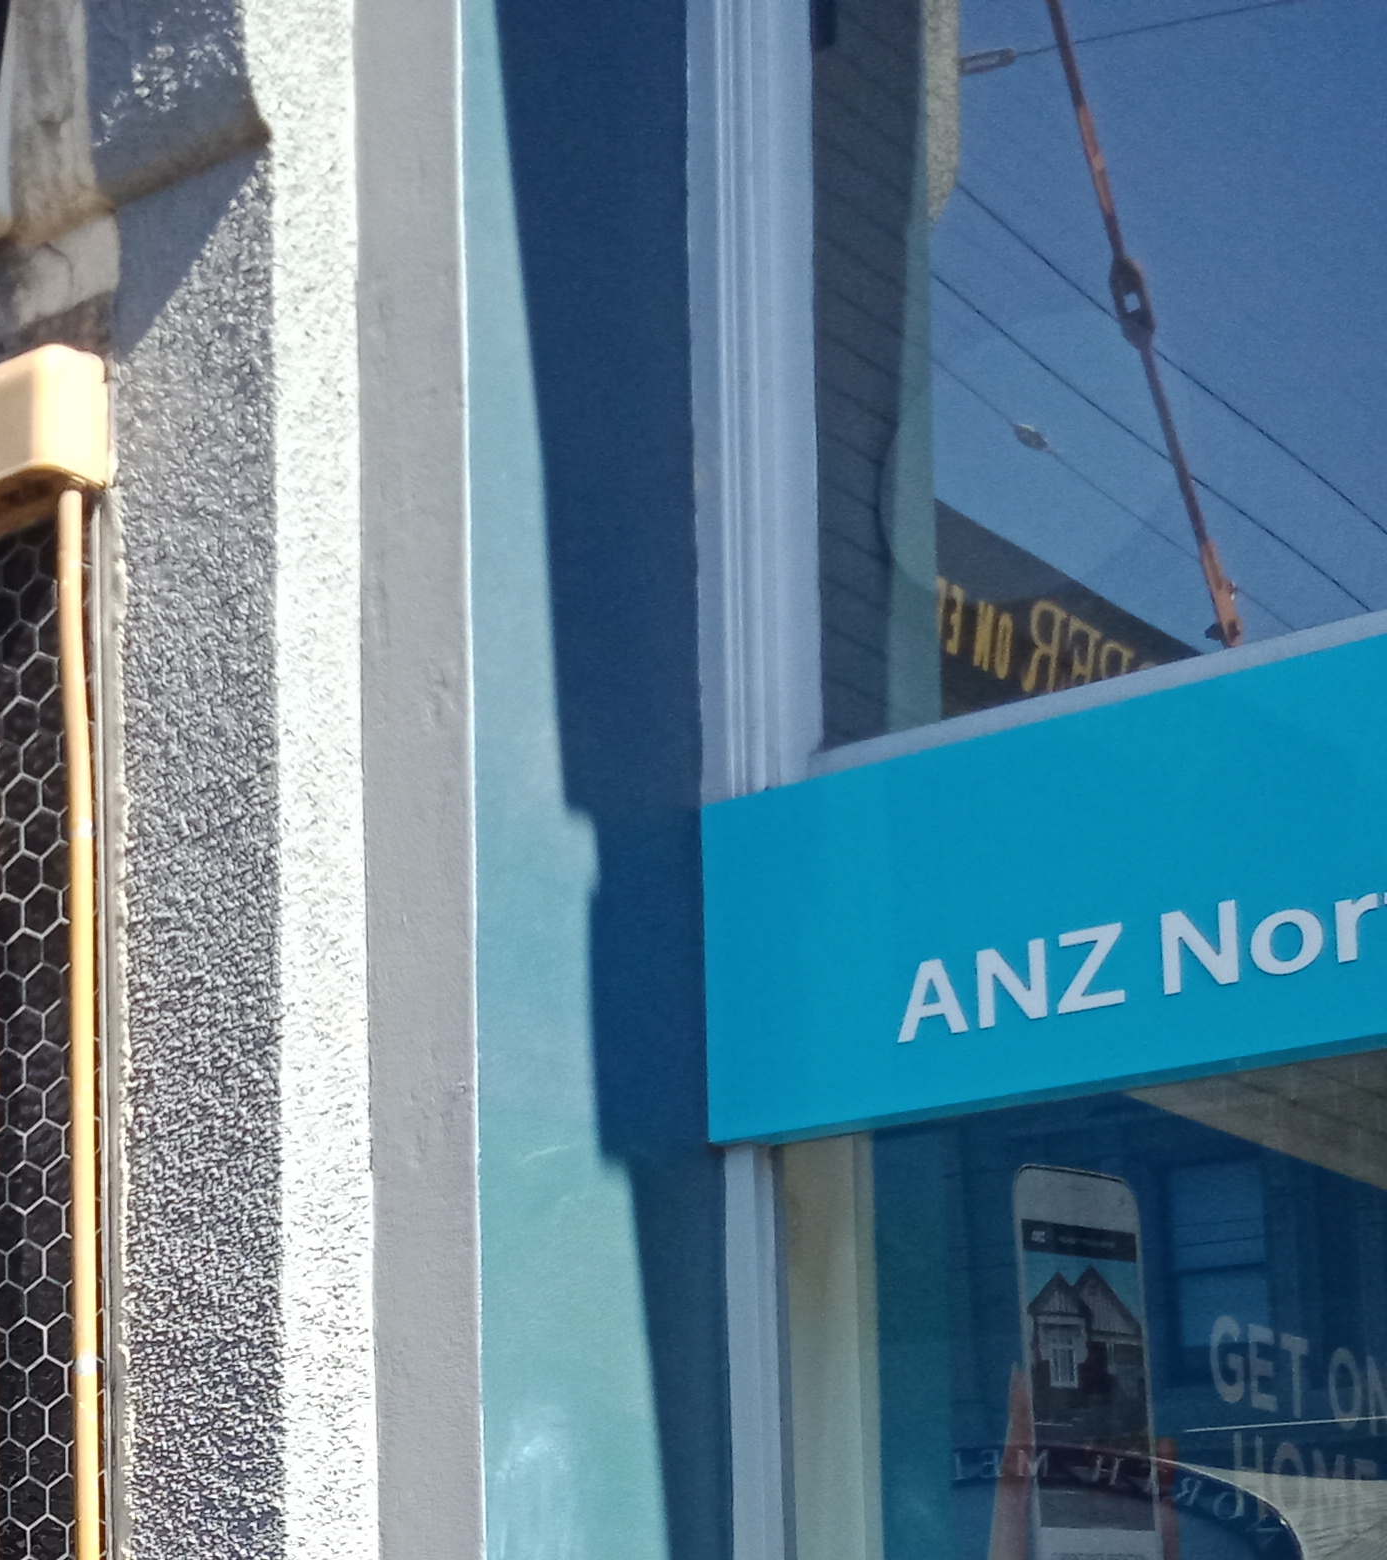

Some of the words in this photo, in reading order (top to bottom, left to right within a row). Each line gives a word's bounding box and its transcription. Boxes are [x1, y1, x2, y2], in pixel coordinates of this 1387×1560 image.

[897, 922, 1126, 1045] ANZ
[1160, 890, 1387, 996] Nor
[1210, 1315, 1309, 1419] GET
